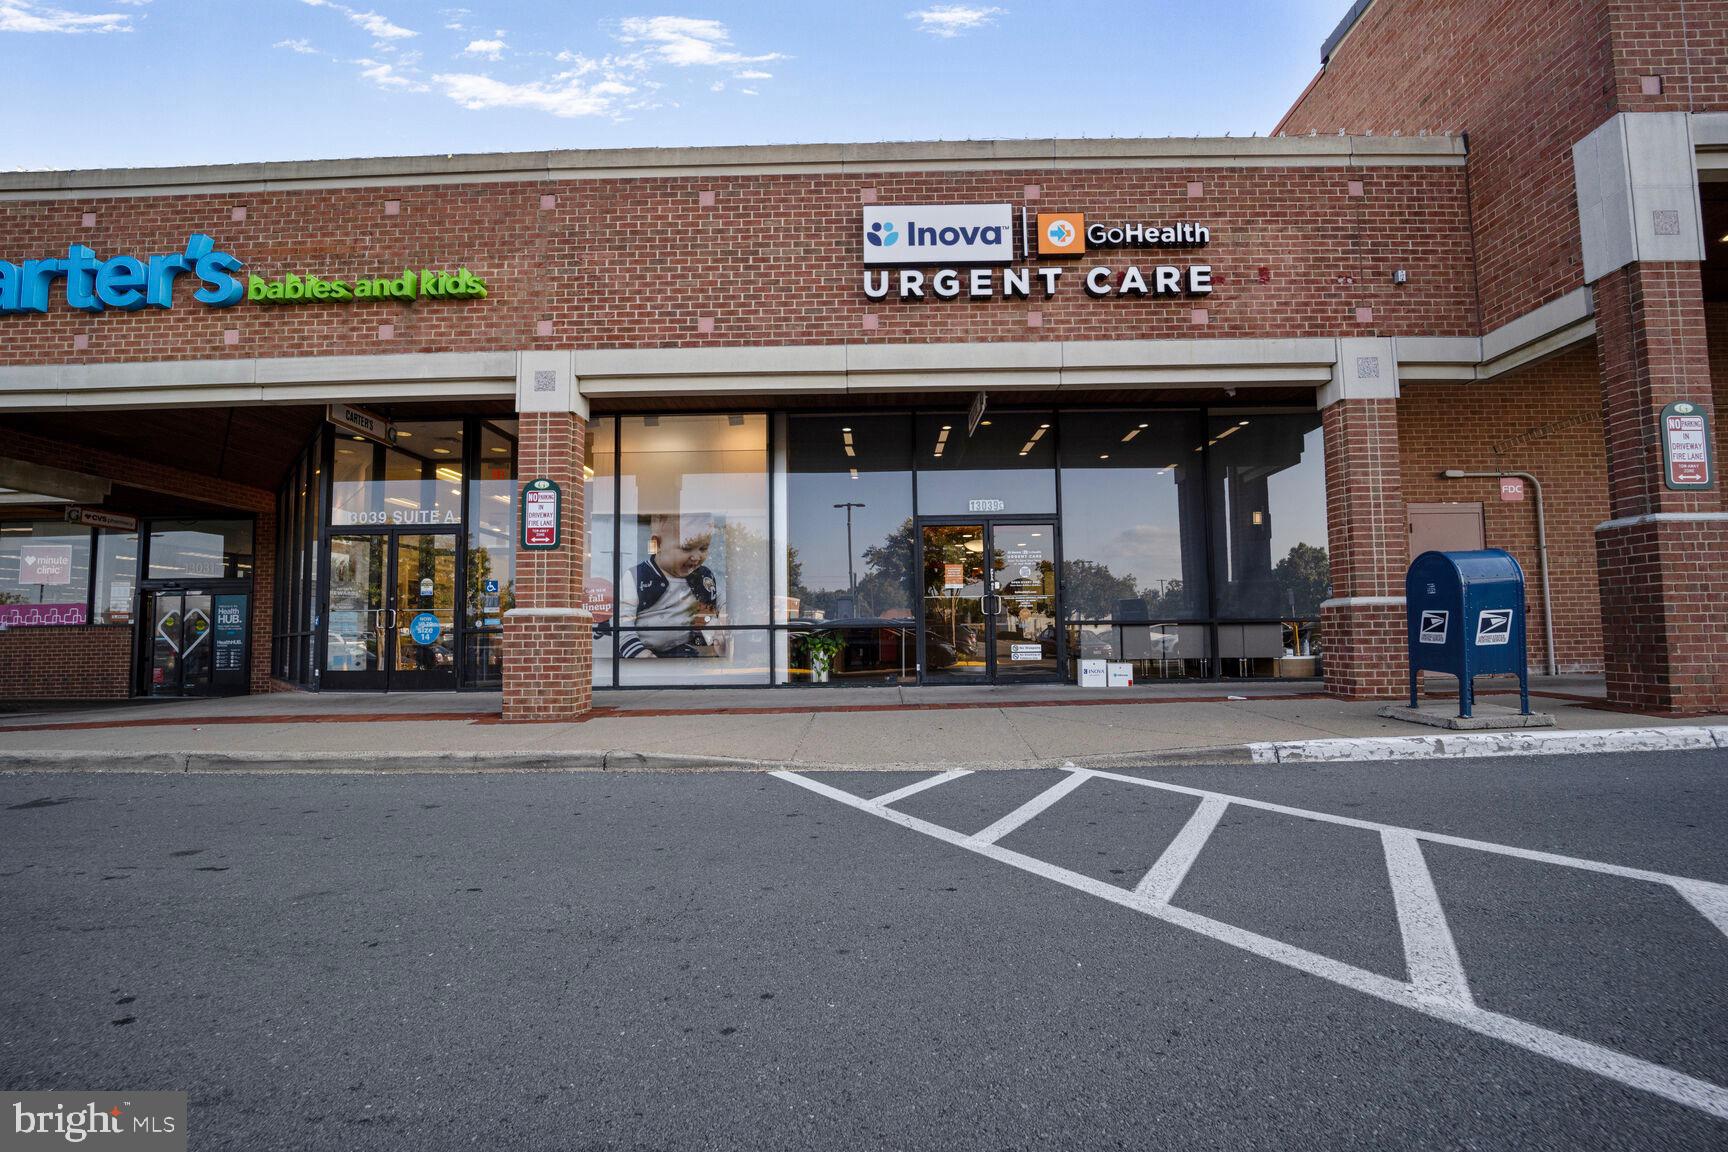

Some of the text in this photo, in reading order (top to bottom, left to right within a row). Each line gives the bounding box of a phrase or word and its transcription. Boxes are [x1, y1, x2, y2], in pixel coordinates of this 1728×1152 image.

[907, 220, 1002, 247] Inova
[1087, 222, 1210, 247] GoHealth
[248, 267, 488, 305] babies and kids
[863, 264, 1213, 299] URGENT CARE
[345, 409, 374, 431] CARTER'S
[1668, 418, 1702, 429] NO PARKING
[1683, 432, 1690, 440] IN
[1672, 442, 1703, 451] DRIVEWAY
[1672, 452, 1704, 460] FIRE LANE
[1502, 485, 1522, 494] FDC
[528, 492, 538, 502] NO
[92, 514, 107, 523] CVS
[393, 510, 440, 523] SUITE
[444, 510, 455, 523] A
[37, 555, 68, 565] minute
[36, 565, 61, 575] clinic
[582, 603, 611, 612] lineup
